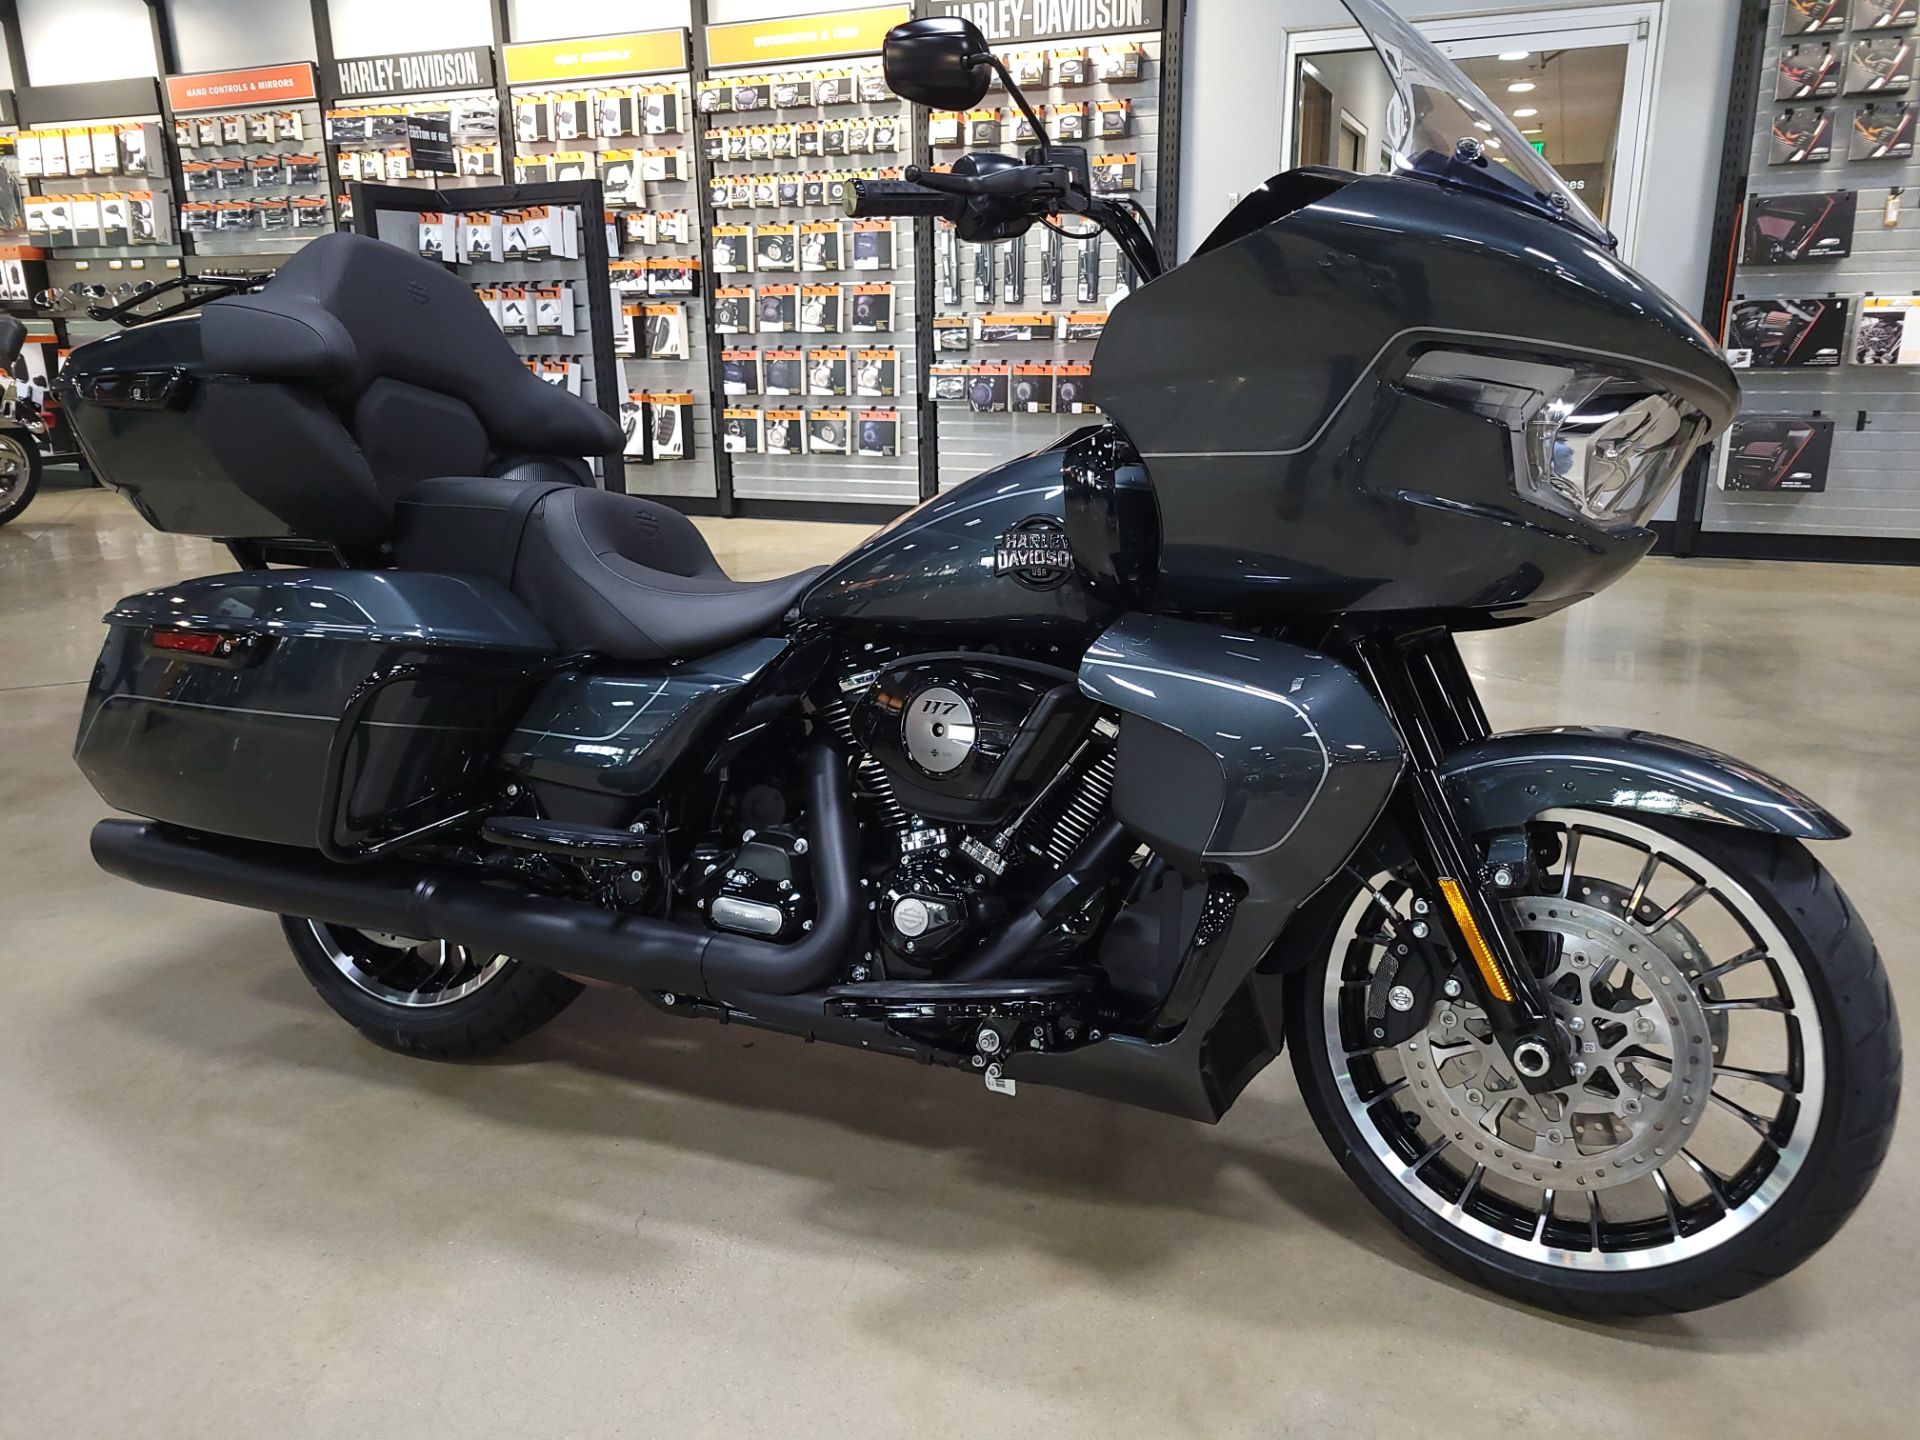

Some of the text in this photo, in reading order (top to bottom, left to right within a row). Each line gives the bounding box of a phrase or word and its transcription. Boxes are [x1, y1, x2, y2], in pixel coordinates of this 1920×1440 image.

[338, 51, 479, 94] HARLEY-DAVIDSON
[186, 78, 294, 96] HAND CONTROLS & MIRRORS
[1006, 533, 1068, 549] HARLEY
[1032, 568, 1047, 576] USA
[922, 699, 960, 715] 117
